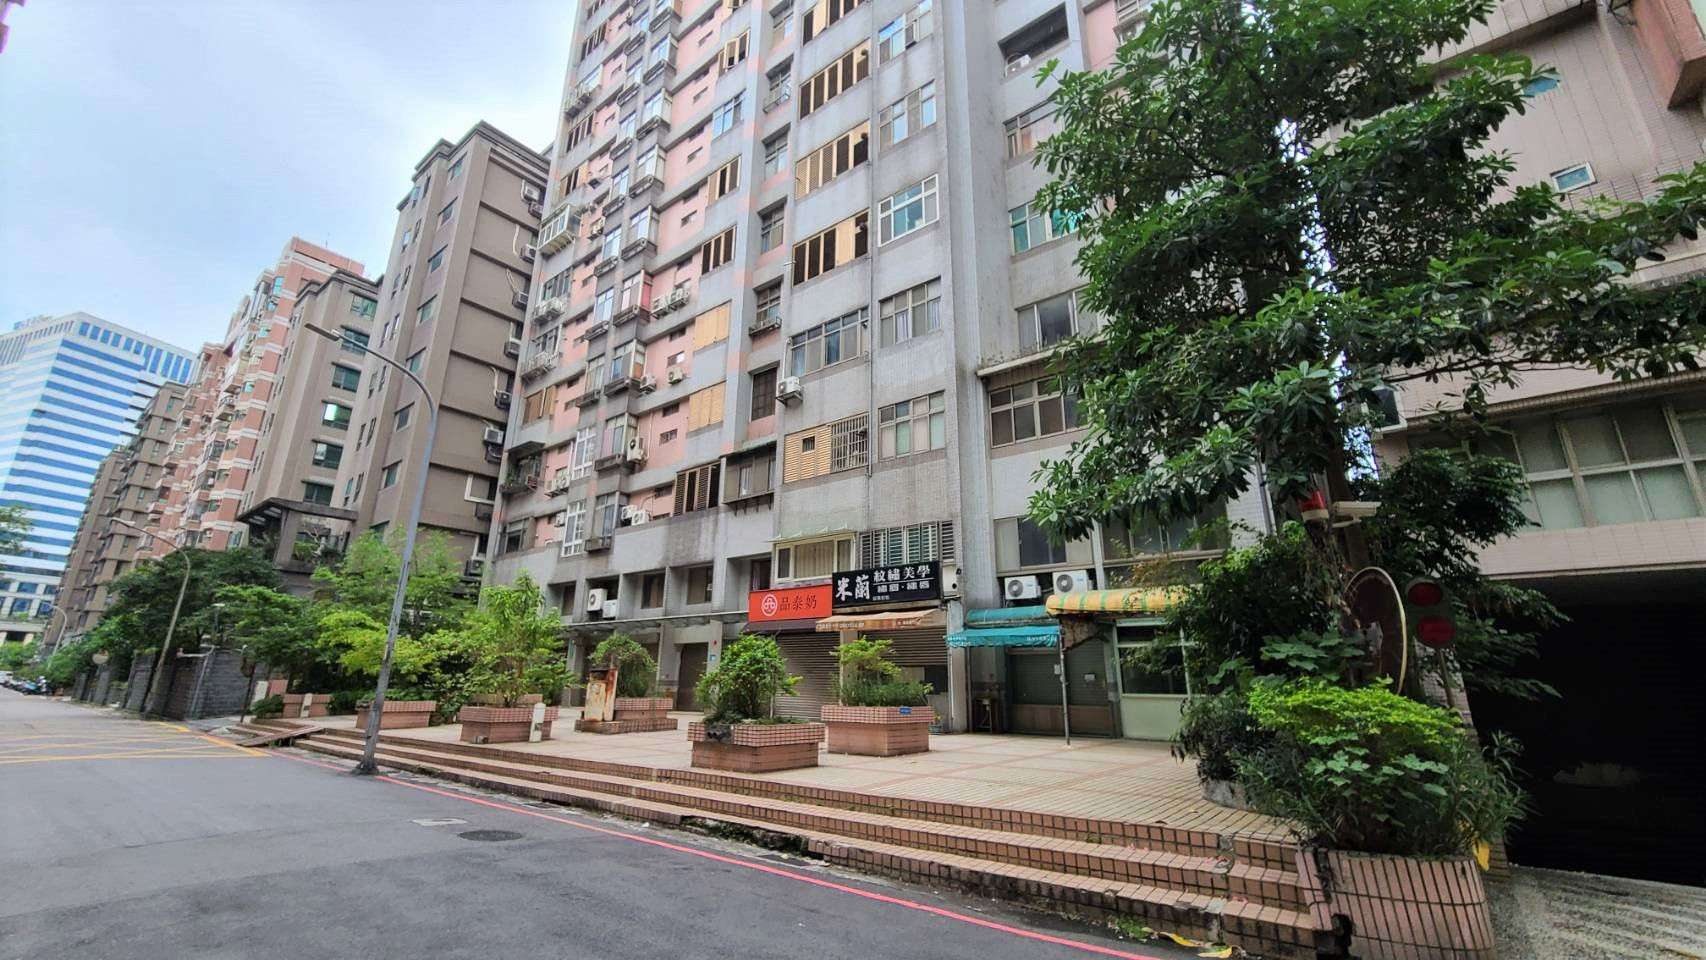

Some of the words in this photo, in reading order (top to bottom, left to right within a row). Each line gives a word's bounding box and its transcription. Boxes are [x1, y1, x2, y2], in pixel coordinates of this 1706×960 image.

[835, 574, 870, 601] 米蘭
[780, 594, 817, 611] 品泰奶
